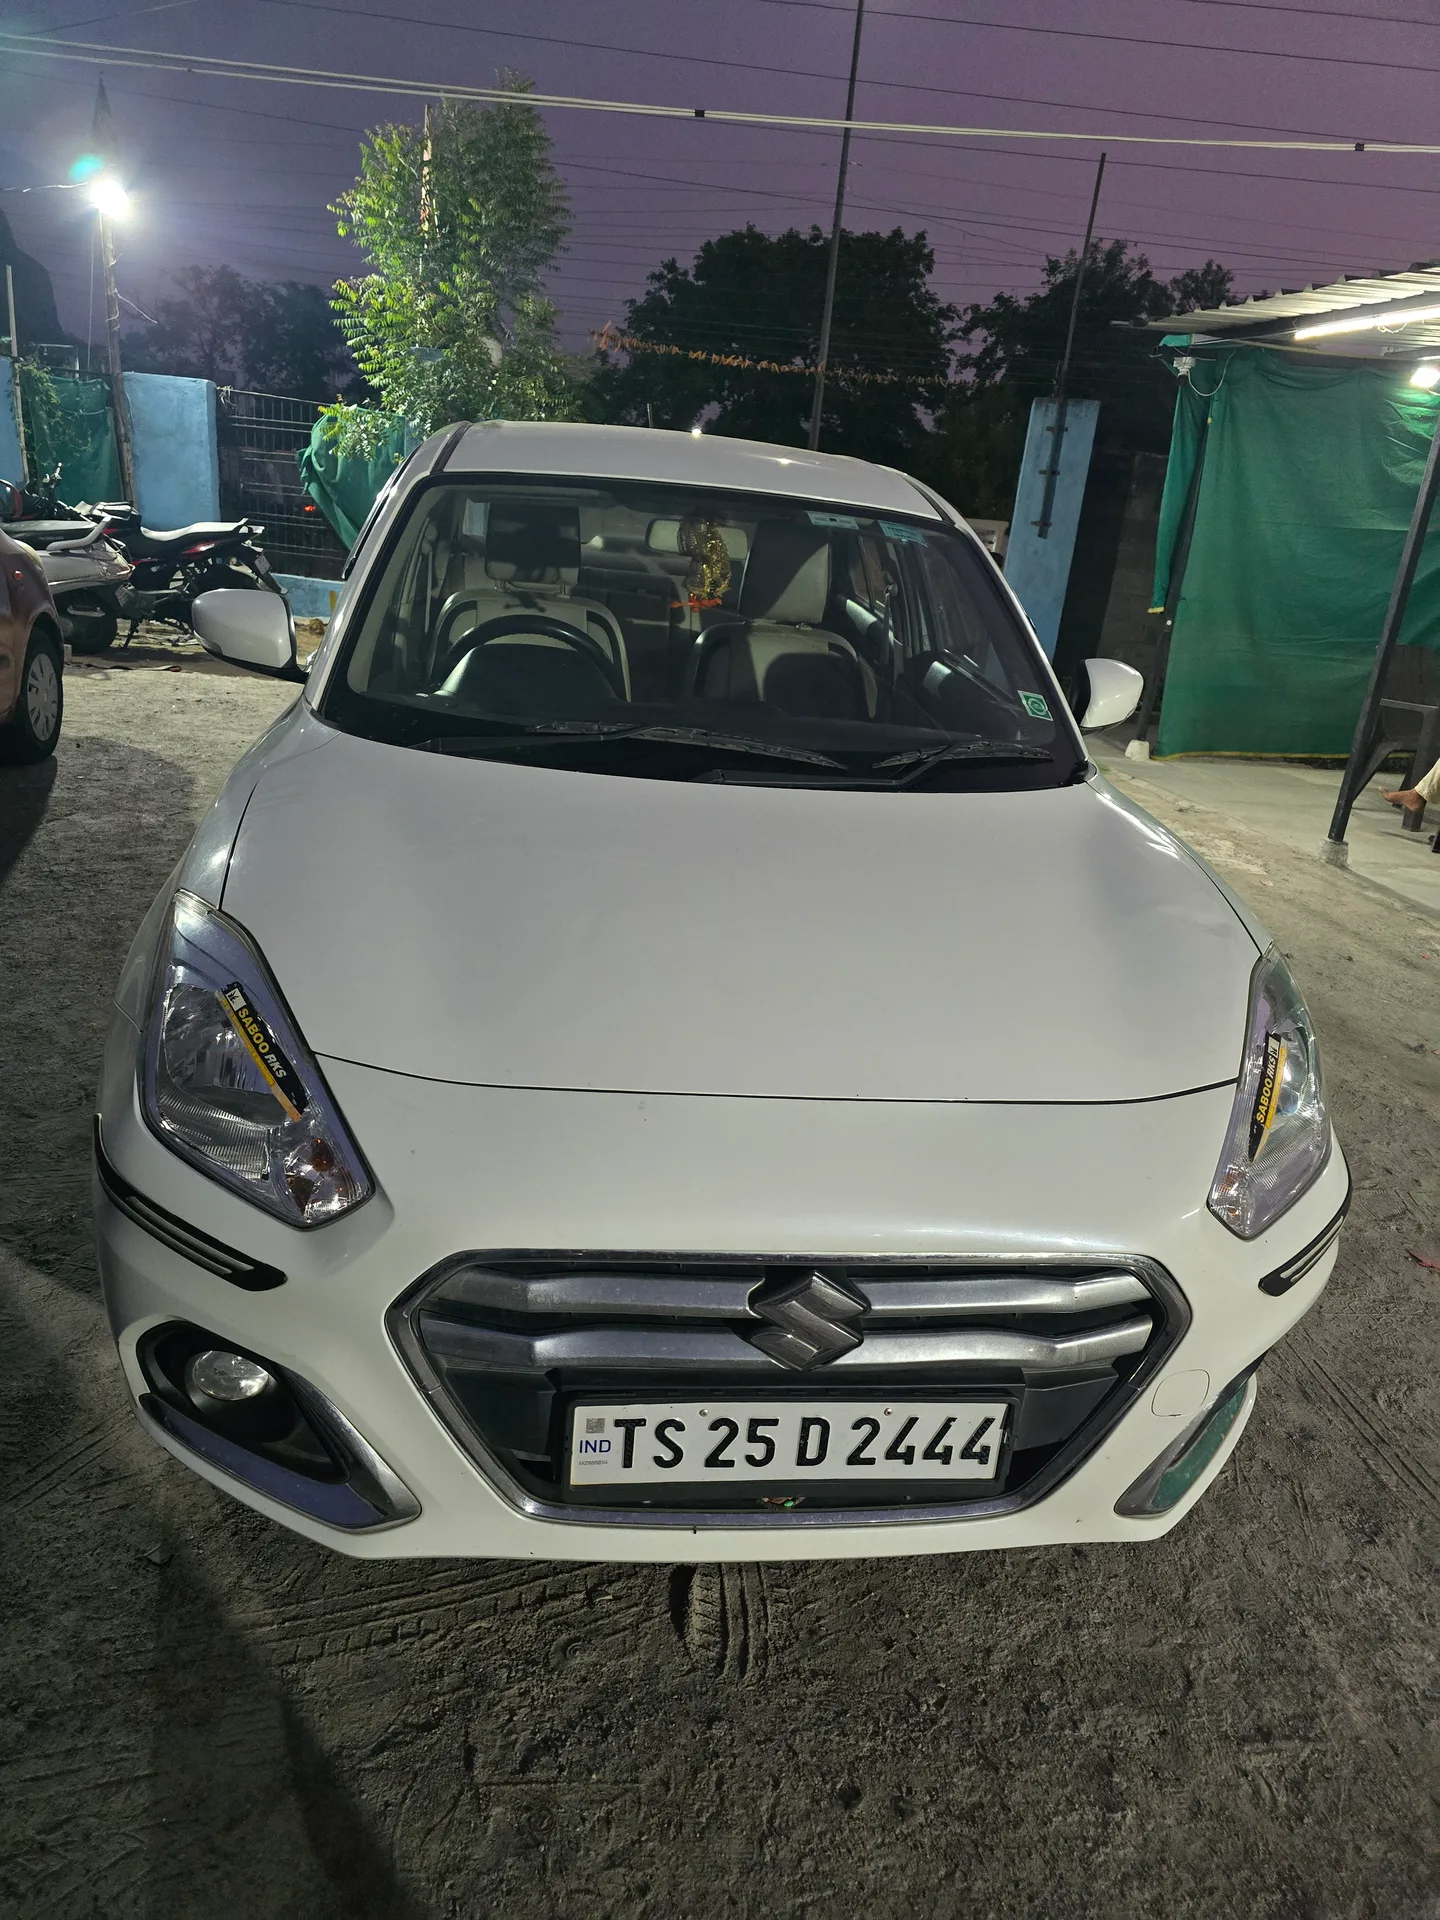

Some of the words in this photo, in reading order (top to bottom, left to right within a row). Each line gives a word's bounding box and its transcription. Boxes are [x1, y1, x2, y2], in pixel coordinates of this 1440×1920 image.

[238, 1008, 270, 1054] SABOO
[264, 1050, 287, 1078] RKS
[1255, 1077, 1273, 1124] SABOO
[1266, 1057, 1276, 1081] RKS
[578, 1439, 612, 1454] IND
[614, 1418, 685, 1469] TS
[704, 1418, 780, 1469] 25
[796, 1416, 831, 1467] D
[846, 1416, 996, 1466] 2444
